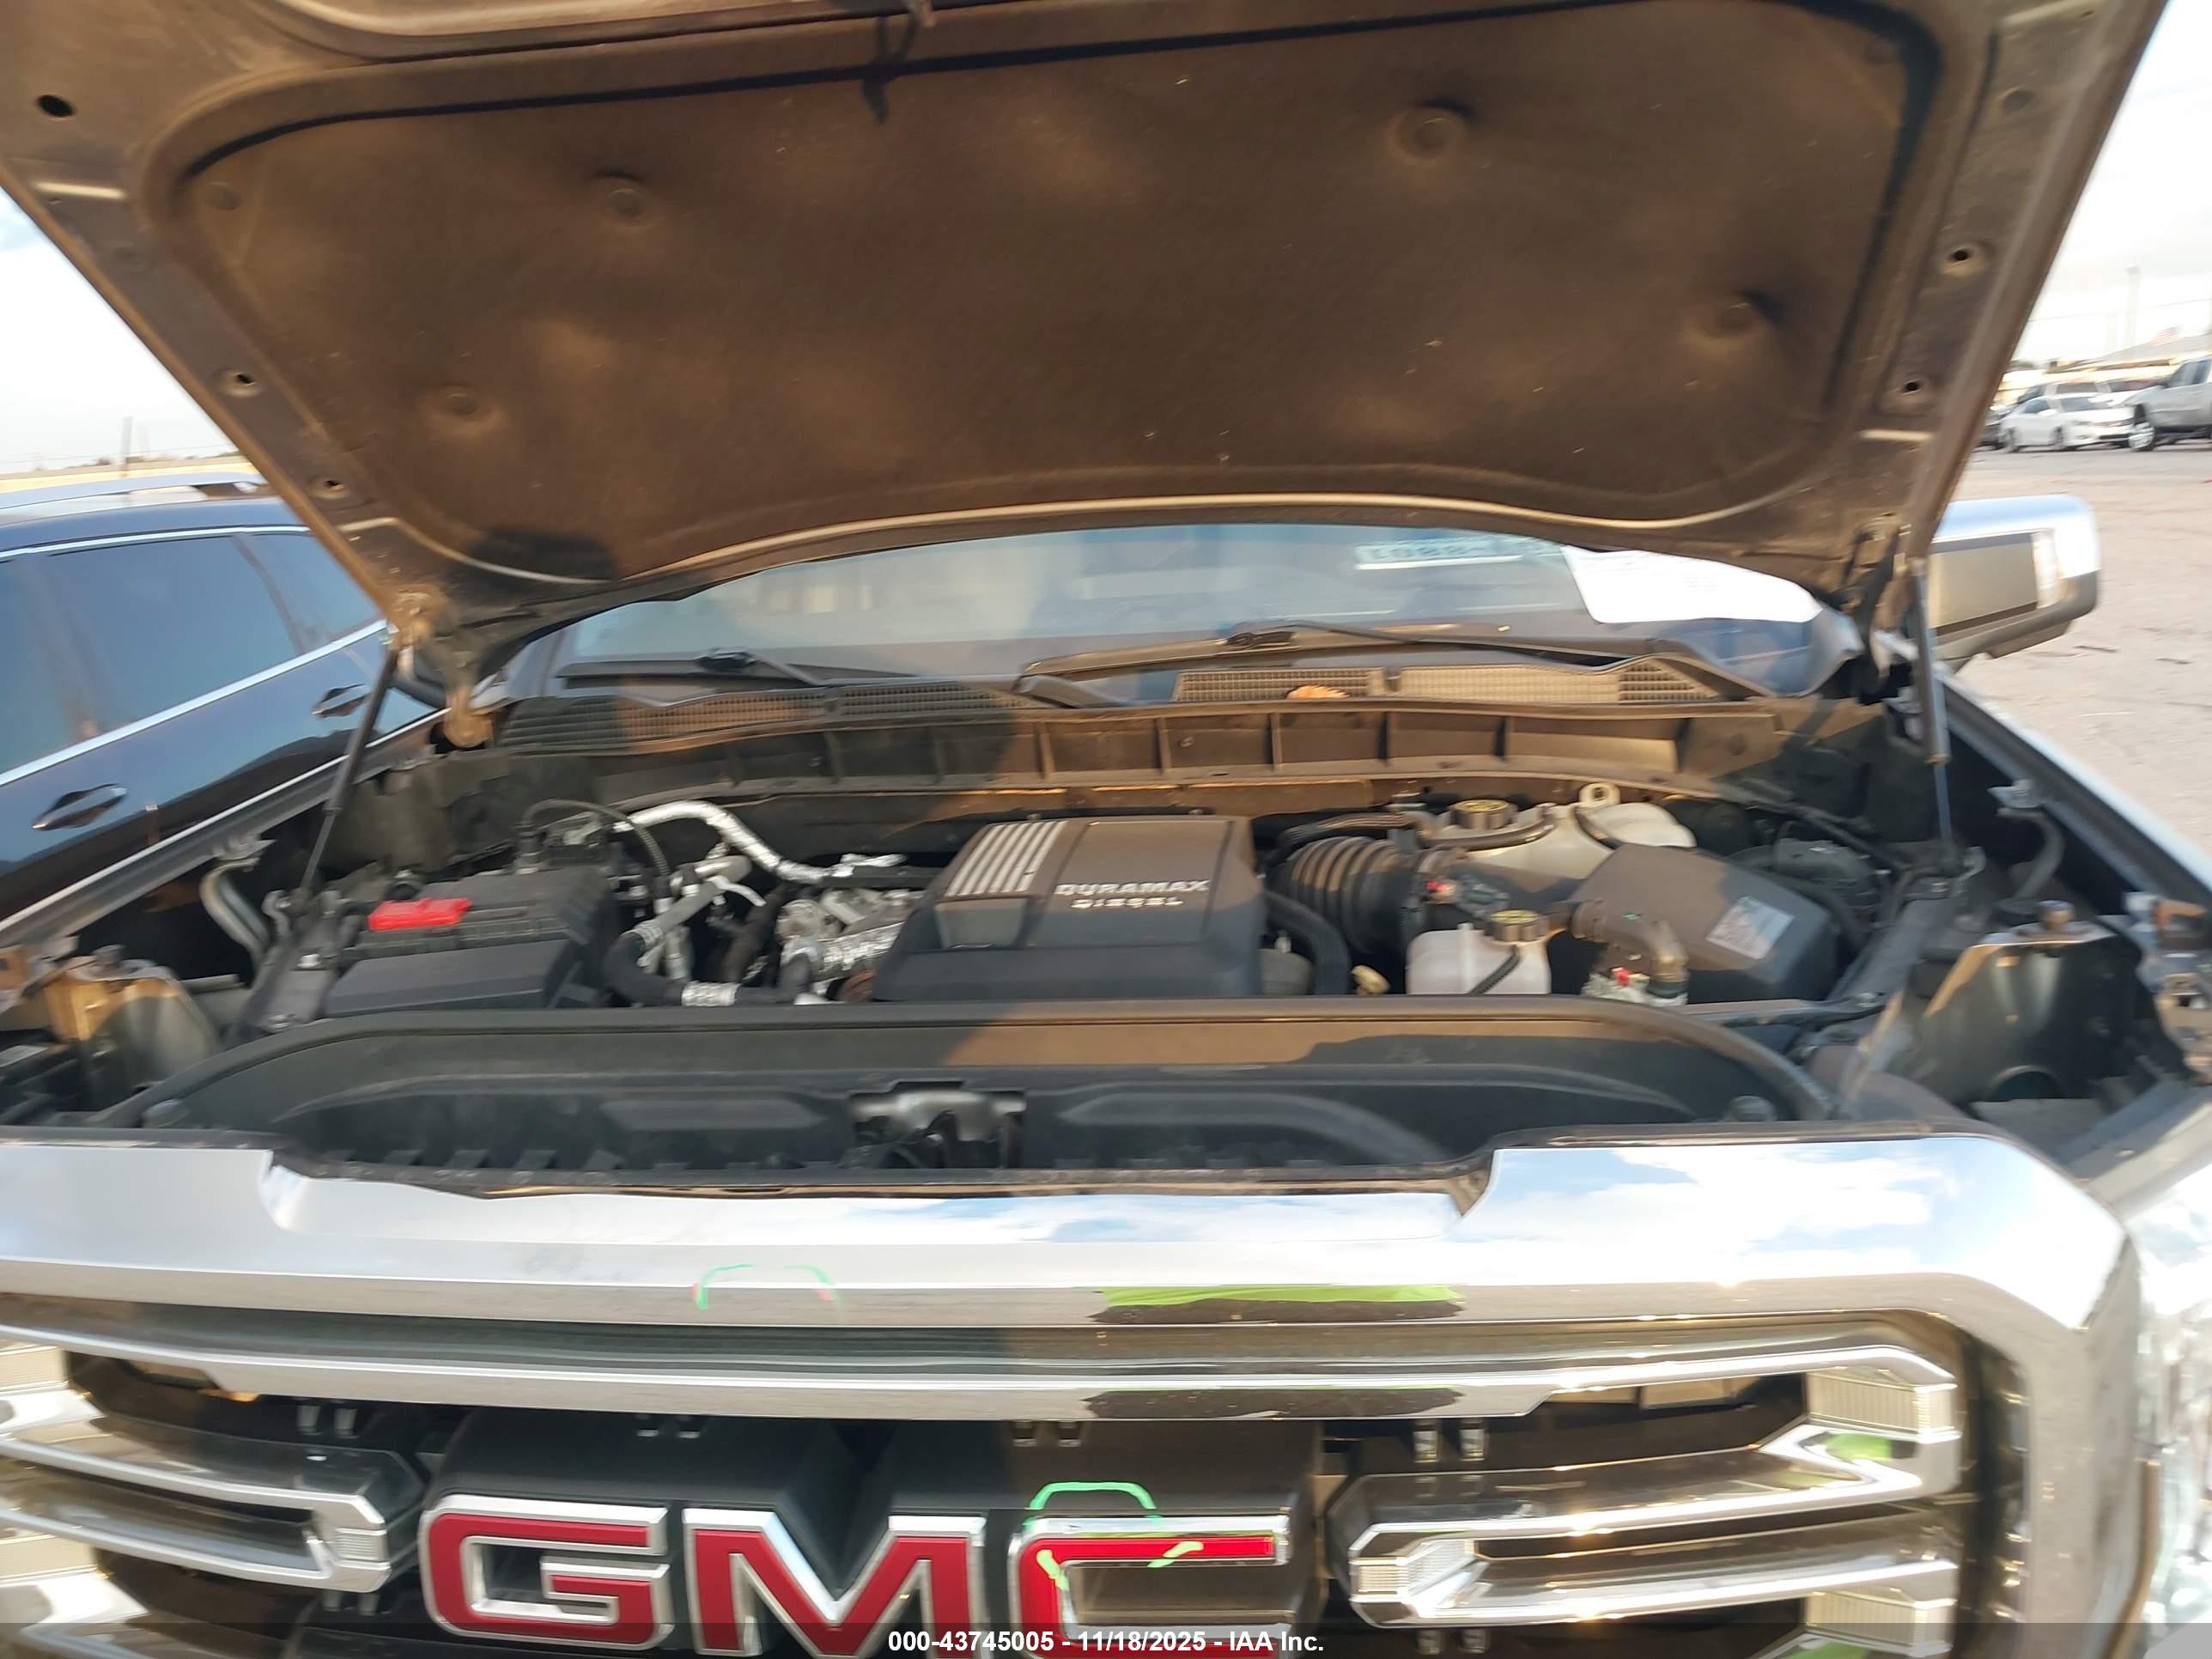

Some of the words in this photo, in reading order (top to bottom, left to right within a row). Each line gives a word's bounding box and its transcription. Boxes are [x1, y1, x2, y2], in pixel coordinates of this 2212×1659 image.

[1054, 879, 1210, 896] DURAMAX
[1071, 896, 1184, 908] DIESEL
[421, 1493, 1291, 1658] GMC
